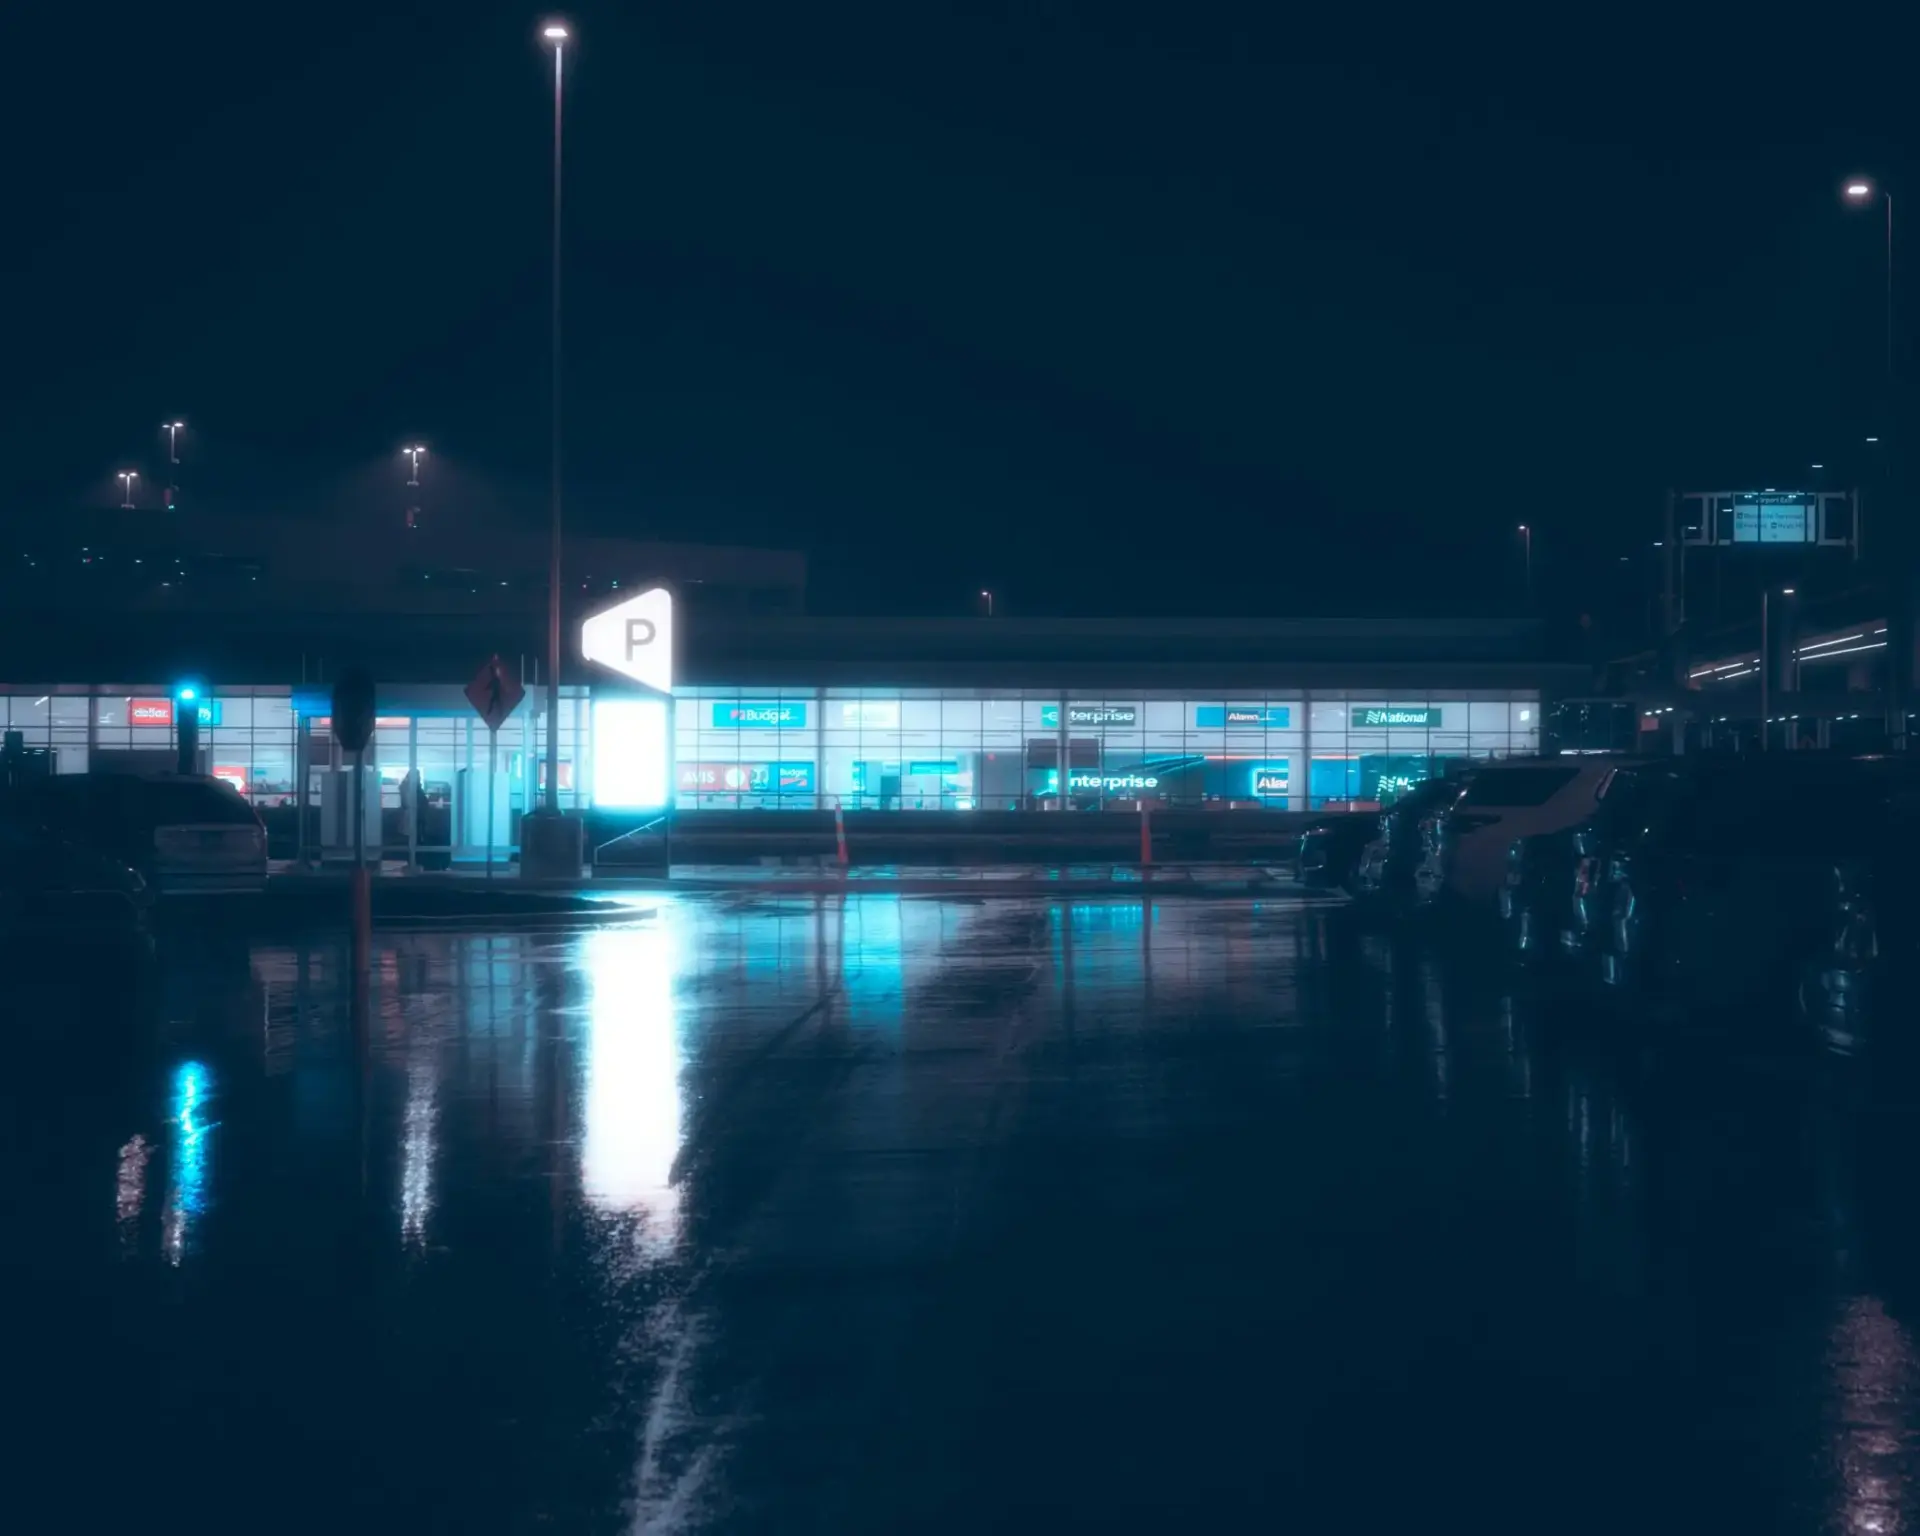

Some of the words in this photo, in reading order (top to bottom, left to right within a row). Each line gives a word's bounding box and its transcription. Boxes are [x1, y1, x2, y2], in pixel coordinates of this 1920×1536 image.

[625, 618, 656, 661] P
[747, 709, 790, 724] Budget
[1228, 712, 1258, 721] Alamo
[1380, 712, 1428, 723] National
[682, 771, 715, 784] AVIS
[780, 769, 808, 777] Budget
